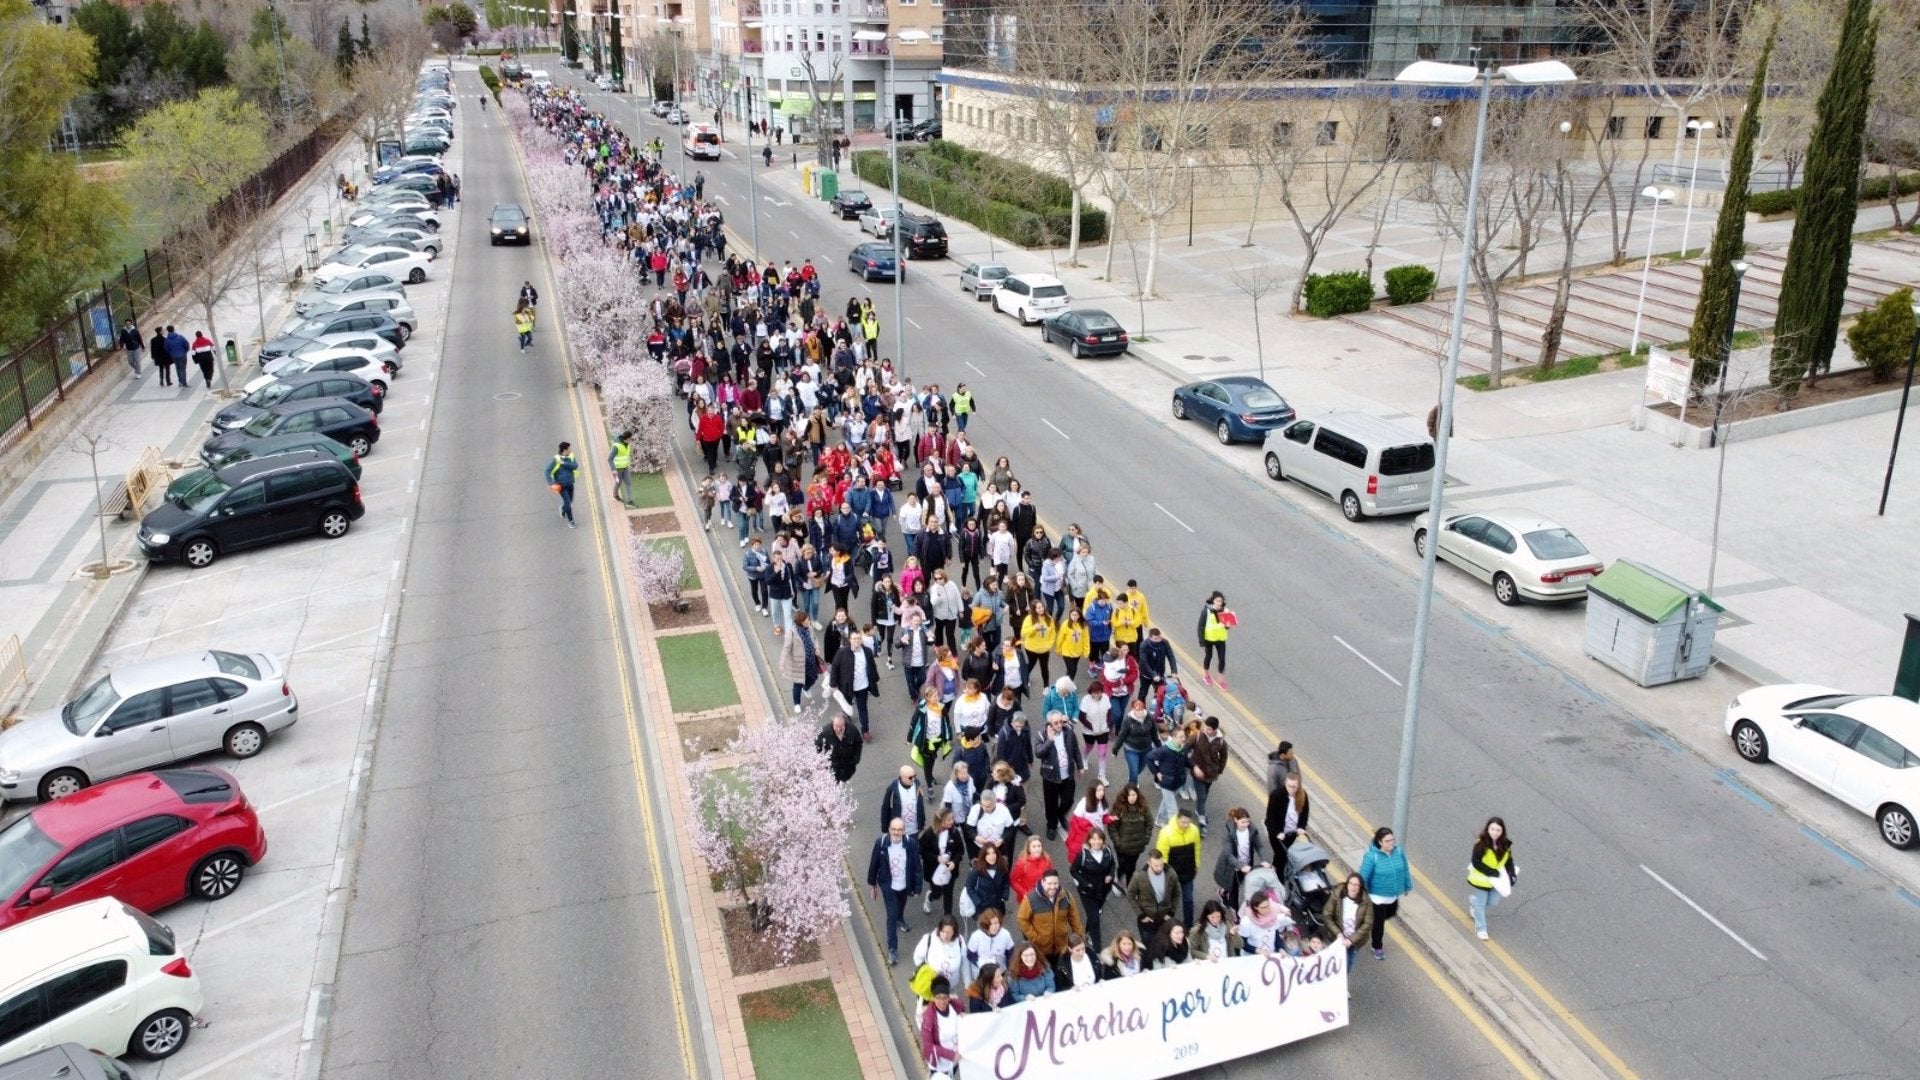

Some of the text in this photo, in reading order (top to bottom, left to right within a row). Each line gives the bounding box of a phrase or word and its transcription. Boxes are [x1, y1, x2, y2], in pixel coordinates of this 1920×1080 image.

[994, 953, 1342, 1080] Marcha por la Vida
[1173, 1043, 1199, 1060] 2019
